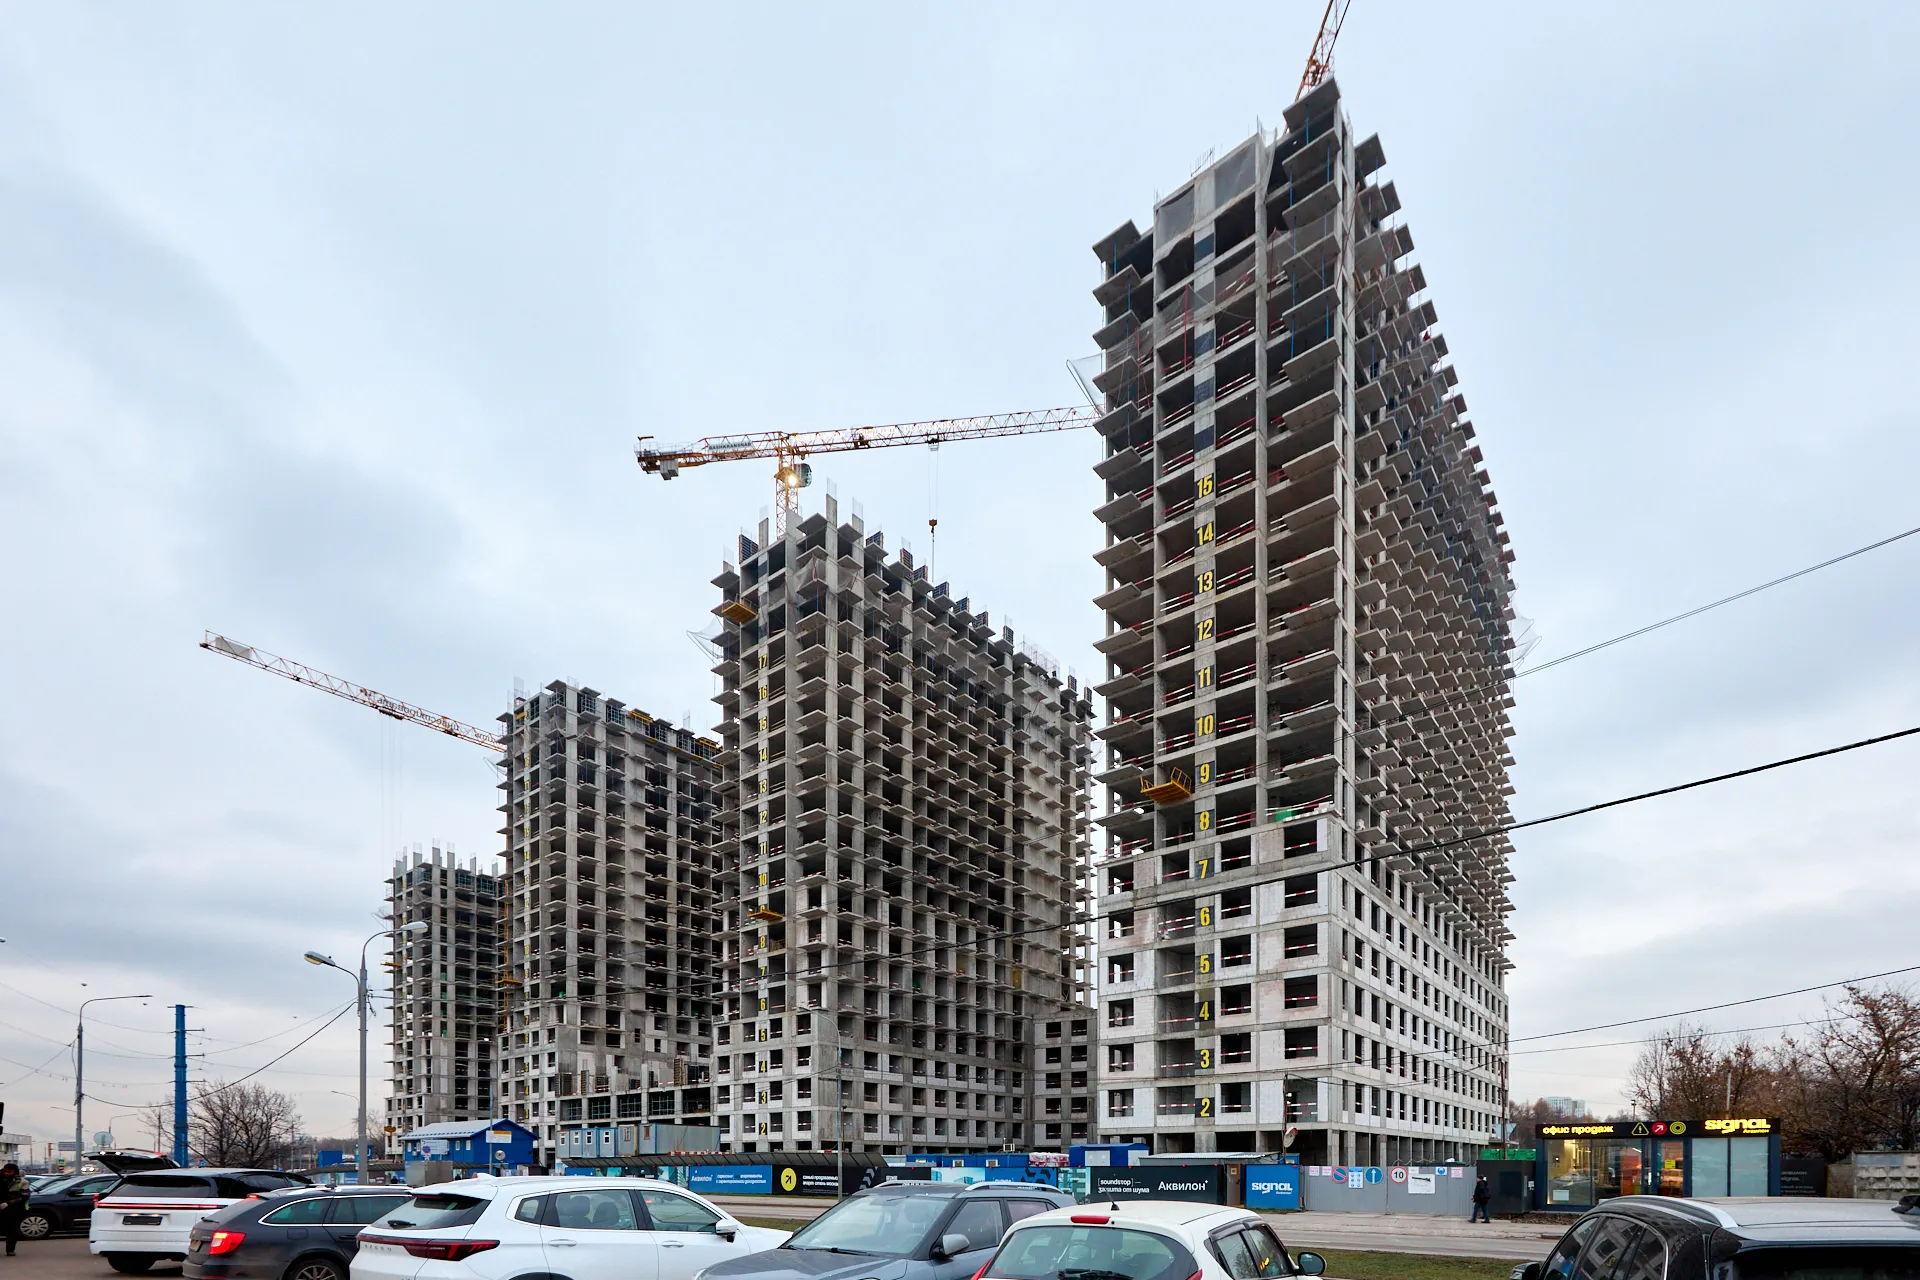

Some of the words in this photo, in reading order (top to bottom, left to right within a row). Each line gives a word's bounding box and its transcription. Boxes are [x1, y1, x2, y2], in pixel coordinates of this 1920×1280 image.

[1197, 474, 1213, 498] 15
[1197, 523, 1214, 546] 14
[1197, 572, 1213, 593] 13
[1197, 619, 1213, 641] 12
[758, 654, 767, 669] 17
[1198, 666, 1212, 687] 11
[758, 686, 767, 700] 16
[758, 717, 767, 731] 15
[1197, 715, 1214, 736] 10
[758, 748, 767, 762] 14
[1199, 763, 1210, 783] 9
[758, 780, 767, 793] 13
[759, 811, 767, 824] 12
[1199, 811, 1210, 830] 8
[759, 843, 767, 855] 11
[1199, 859, 1209, 879] 7
[759, 873, 768, 887] 10
[1199, 907, 1210, 926] 6
[760, 936, 766, 949] 8
[1199, 954, 1210, 974] 5
[760, 998, 766, 1011] 6
[1199, 1001, 1210, 1020] 4
[760, 1028, 766, 1041] 5
[1199, 1049, 1210, 1068] 3
[760, 1061, 766, 1073] 4
[761, 1092, 767, 1105] 3
[1199, 1098, 1210, 1117] 2
[761, 1123, 767, 1136] 2
[1543, 1125, 1570, 1135] офис
[1571, 1125, 1614, 1135] продаж
[1393, 1171, 1404, 1179] 10
[1132, 1187, 1150, 1195] шума
[1158, 1181, 1206, 1191] Аквилон
